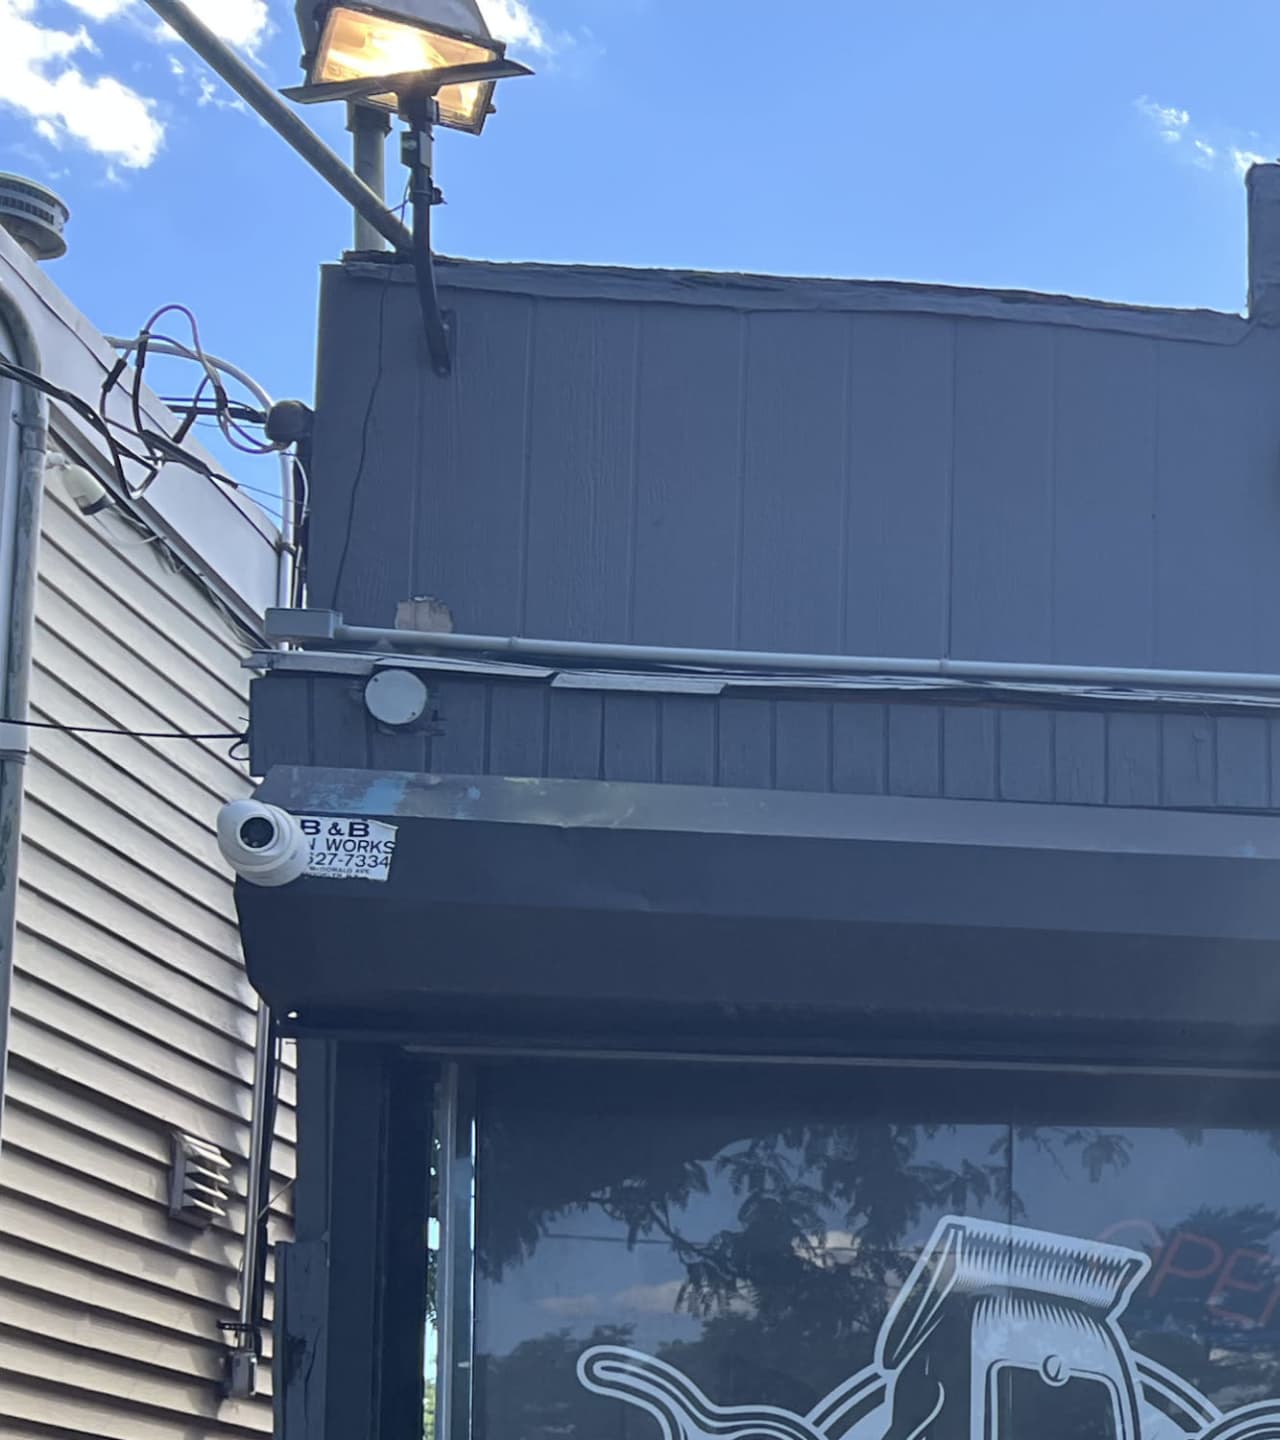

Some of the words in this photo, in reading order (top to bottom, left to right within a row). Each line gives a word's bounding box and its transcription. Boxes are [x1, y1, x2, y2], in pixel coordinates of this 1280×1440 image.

[301, 820, 321, 835] B
[328, 822, 345, 836] &
[348, 822, 369, 837] B
[326, 838, 396, 854] WORKS
